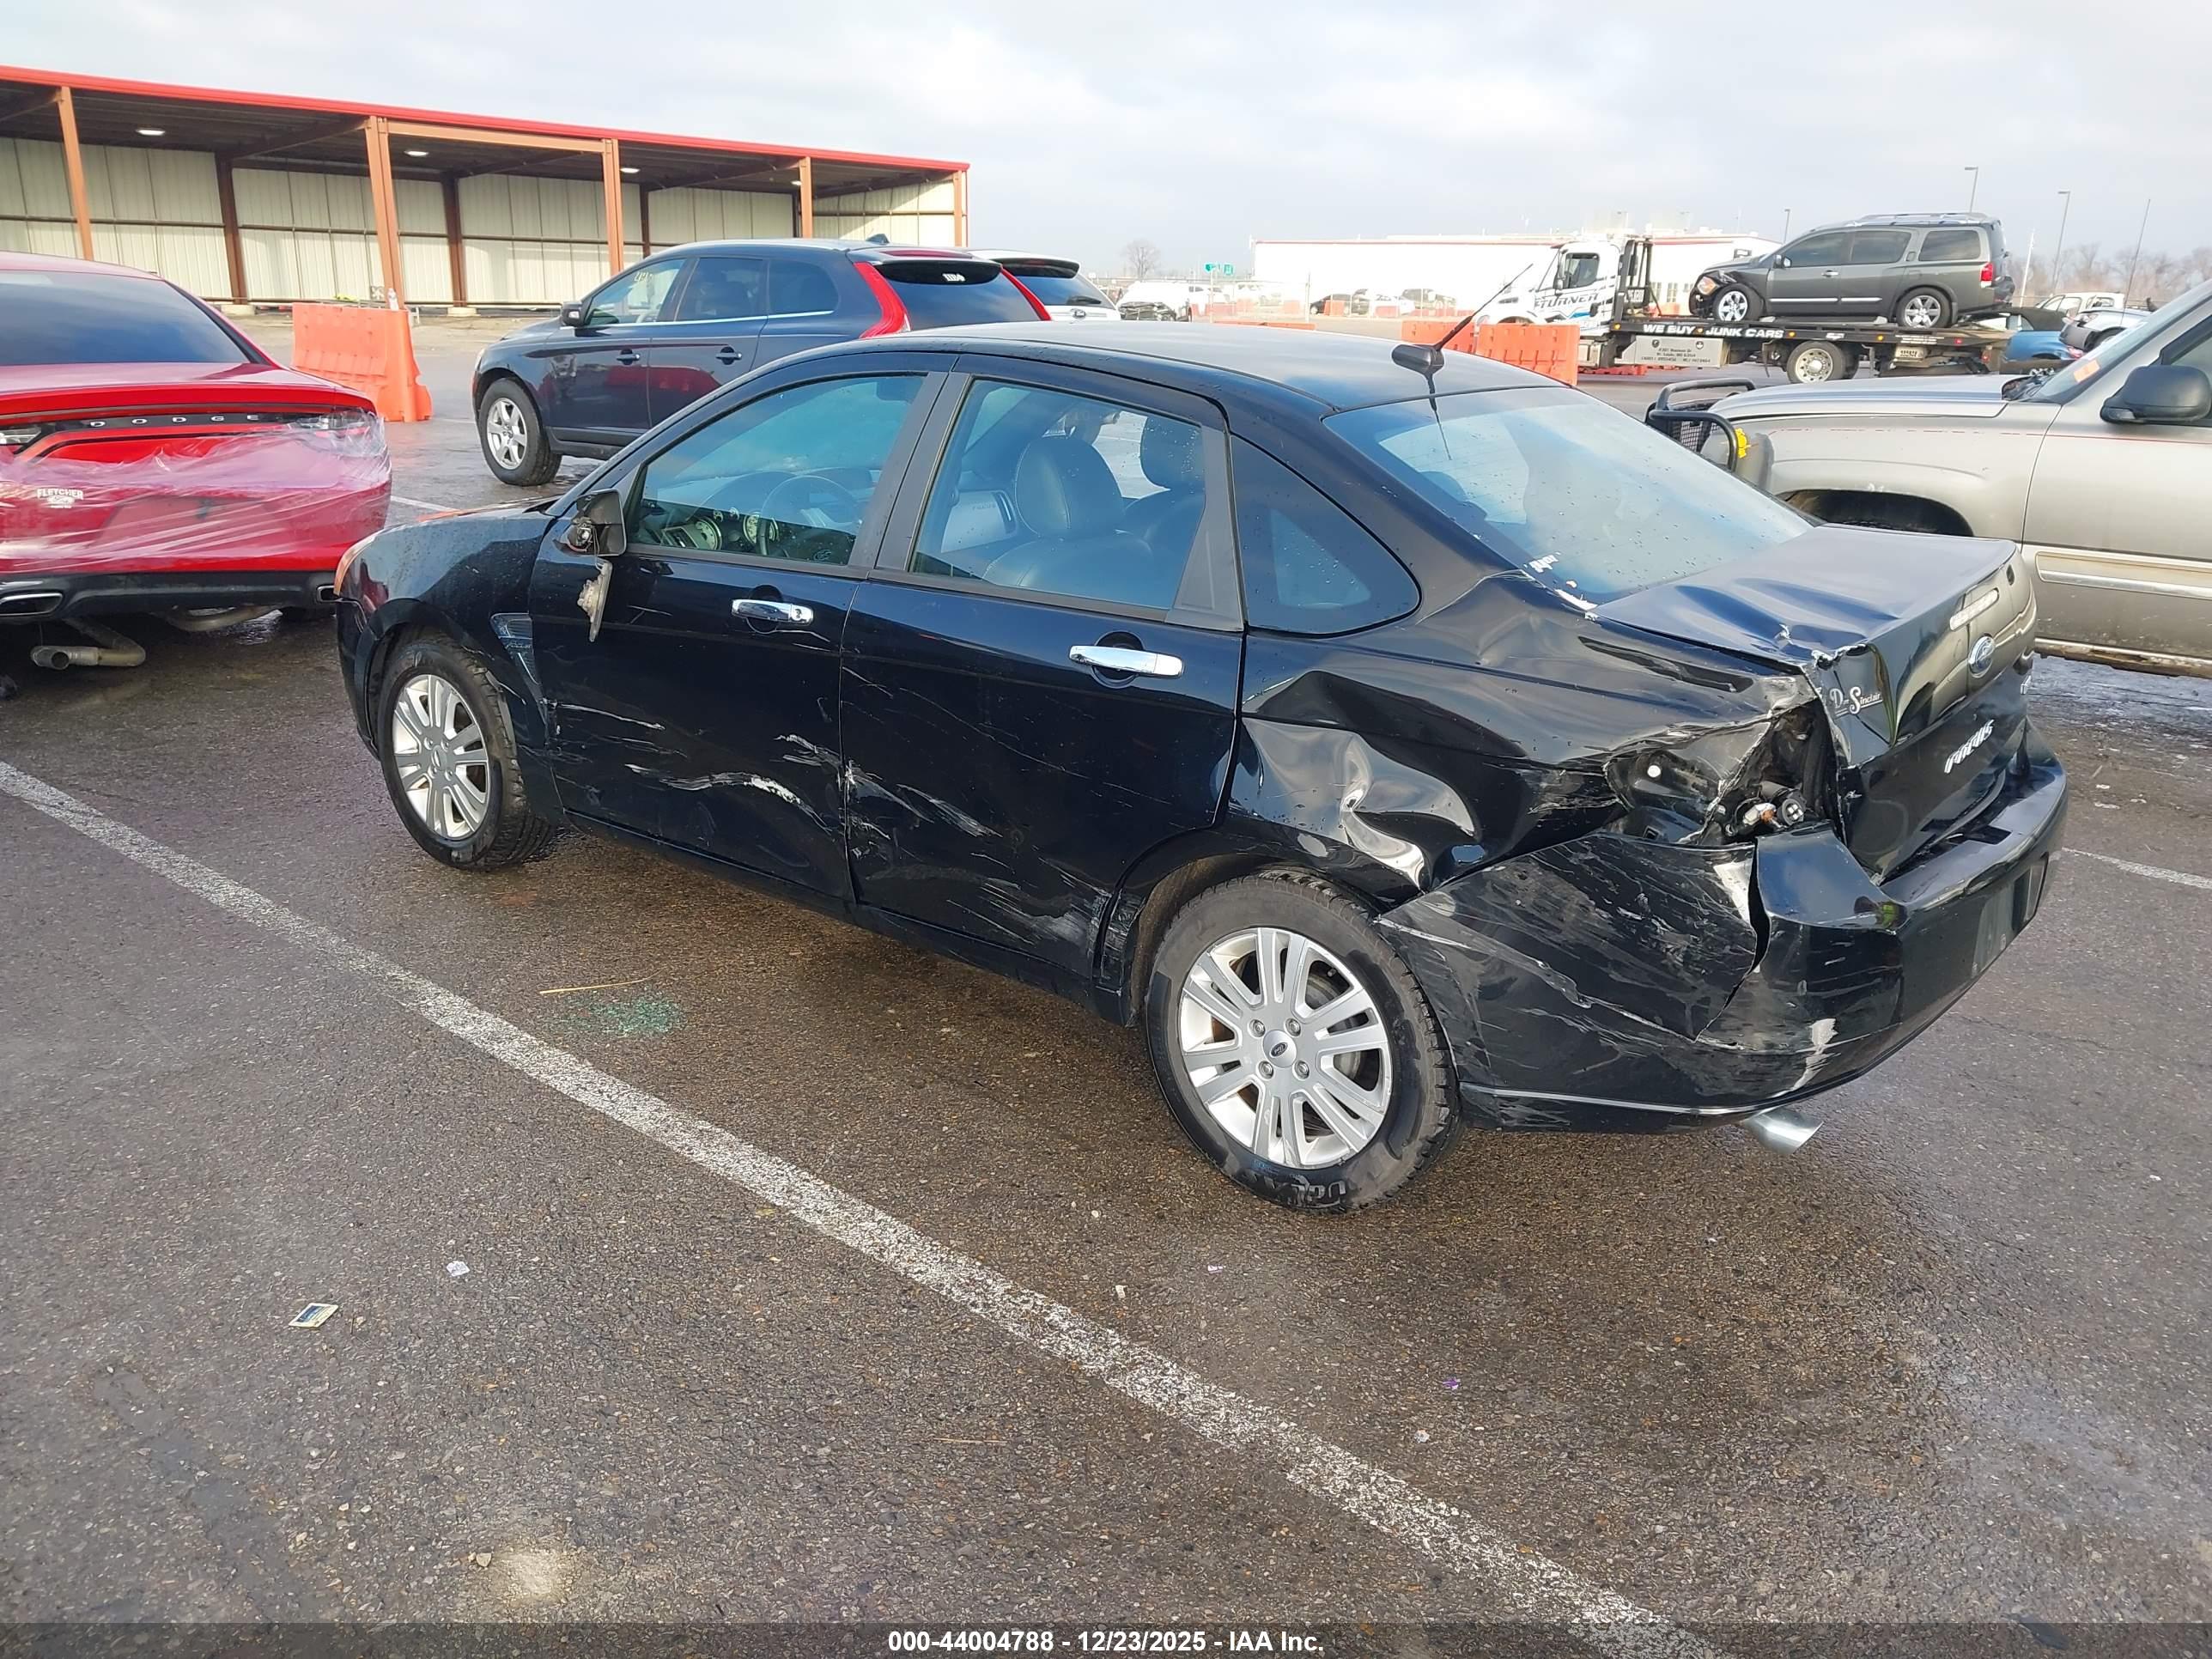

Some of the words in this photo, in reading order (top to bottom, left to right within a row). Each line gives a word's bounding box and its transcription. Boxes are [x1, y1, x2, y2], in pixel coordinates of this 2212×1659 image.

[1535, 292, 1598, 308] TURNER
[1643, 324, 1665, 333] WE
[1667, 325, 1695, 335] BUY
[1705, 326, 1743, 337] JUNK
[1745, 329, 1784, 338] CARS
[90, 415, 261, 428] DODGE
[37, 488, 84, 500] FLETCHER
[1850, 687, 1881, 714] Sinclair
